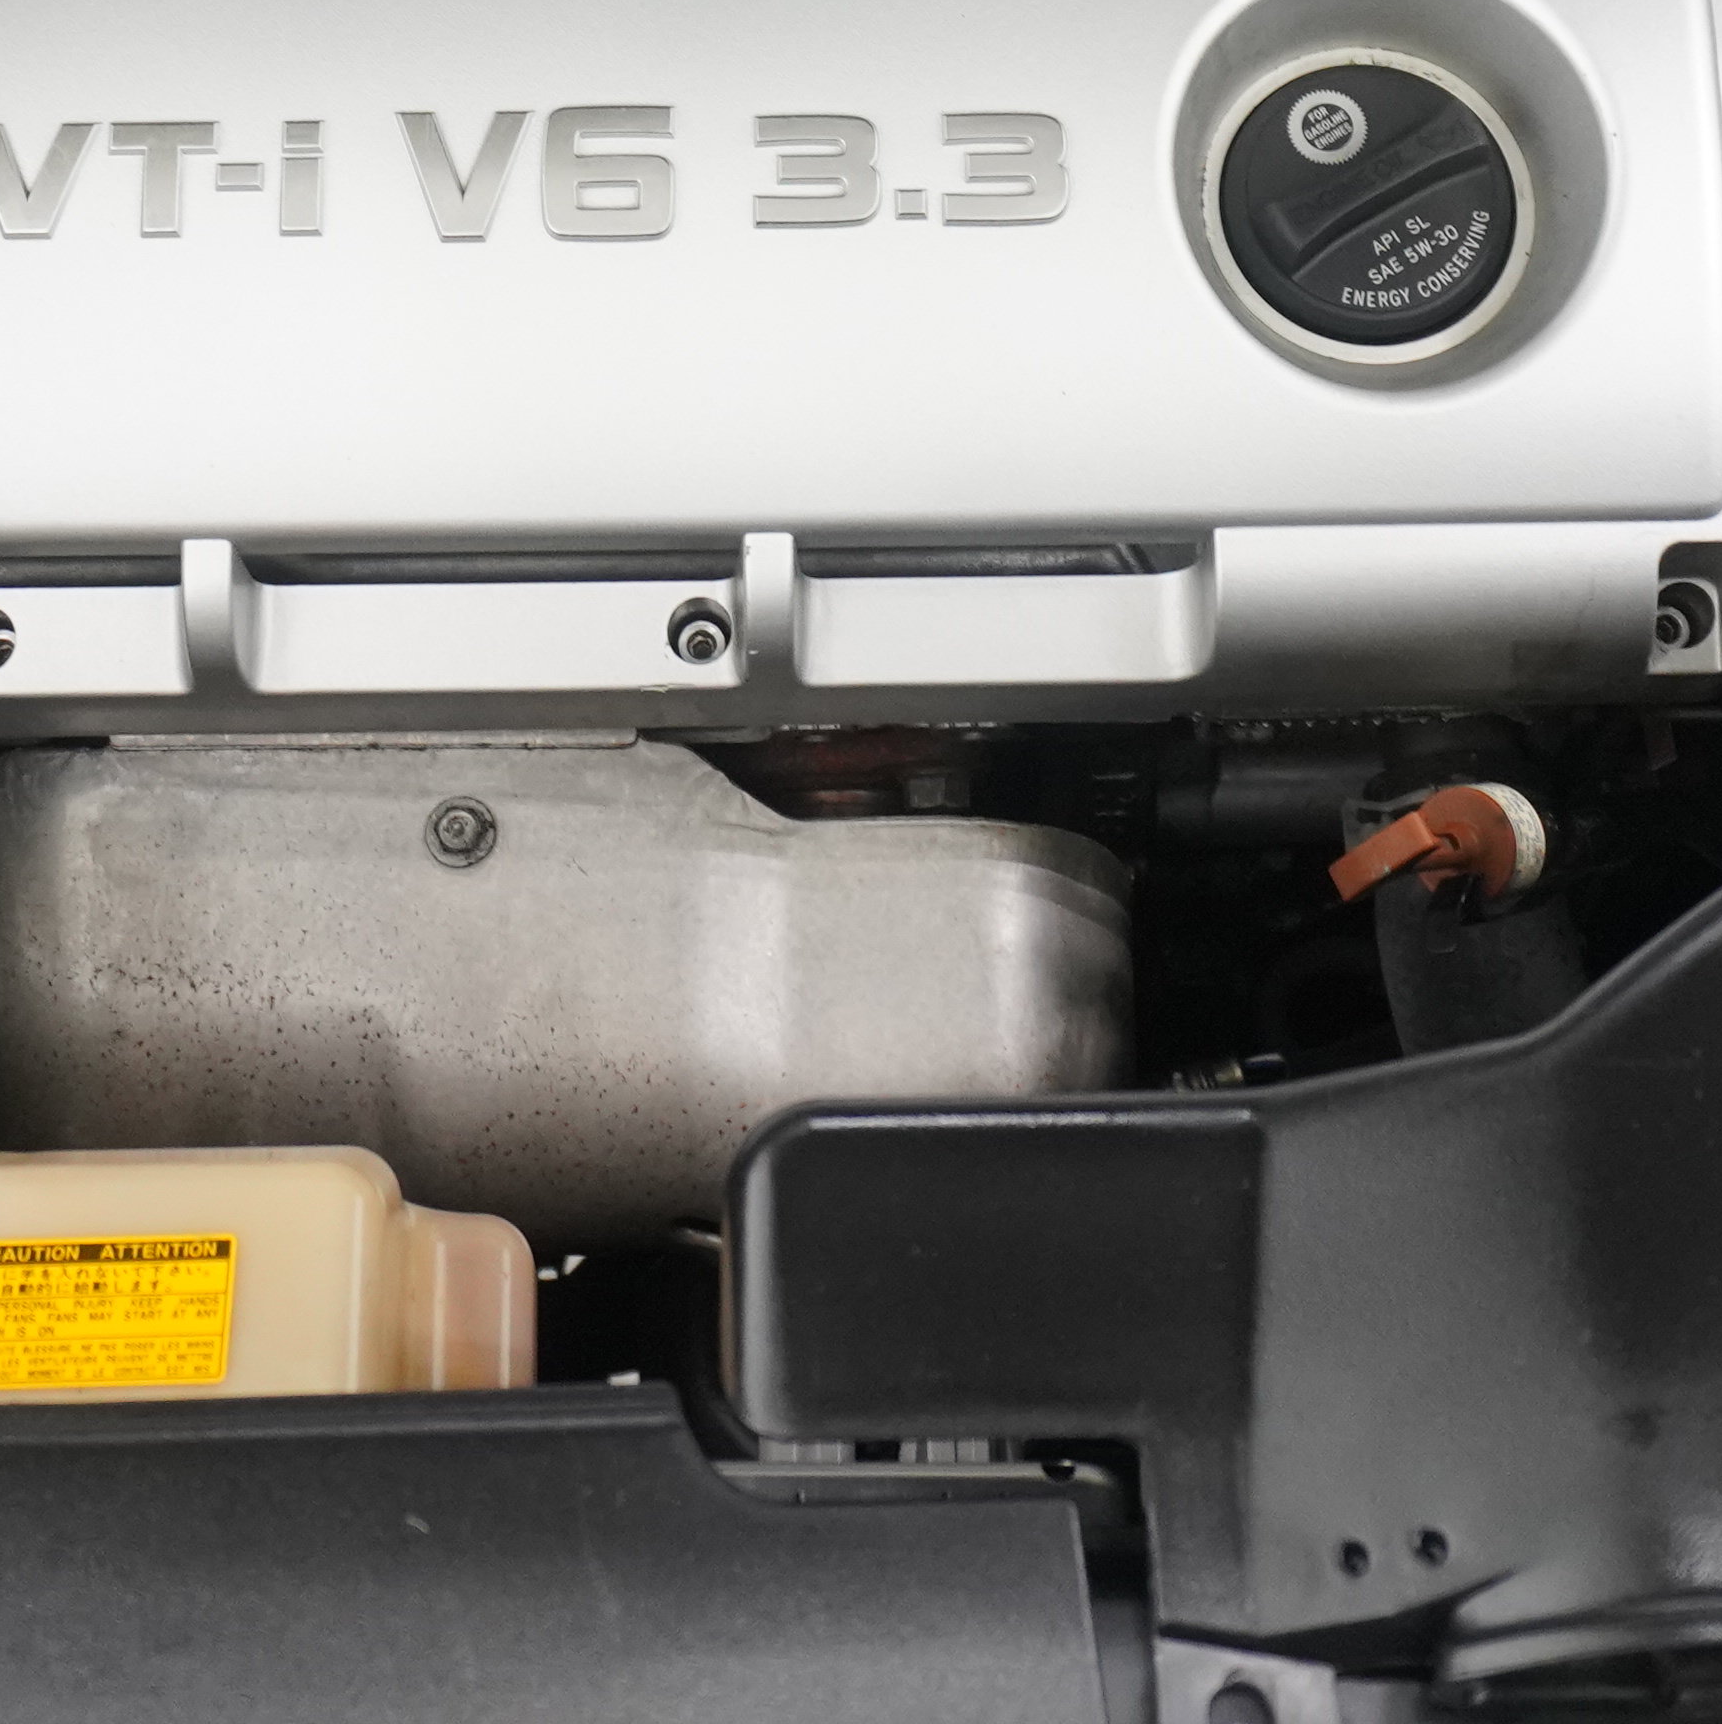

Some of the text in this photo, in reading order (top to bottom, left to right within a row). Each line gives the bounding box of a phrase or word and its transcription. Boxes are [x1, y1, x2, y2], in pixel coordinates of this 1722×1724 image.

[1303, 108, 1351, 142] GASOLINE
[1307, 105, 1330, 123] FOR
[392, 102, 678, 244] V6
[750, 109, 1073, 230] 3.3
[1367, 223, 1460, 286] SAE 5W-30
[1371, 214, 1431, 257] API SL
[1340, 208, 1491, 308] ENERGY CONSERVING
[99, 1241, 218, 1260] ATTENTION
